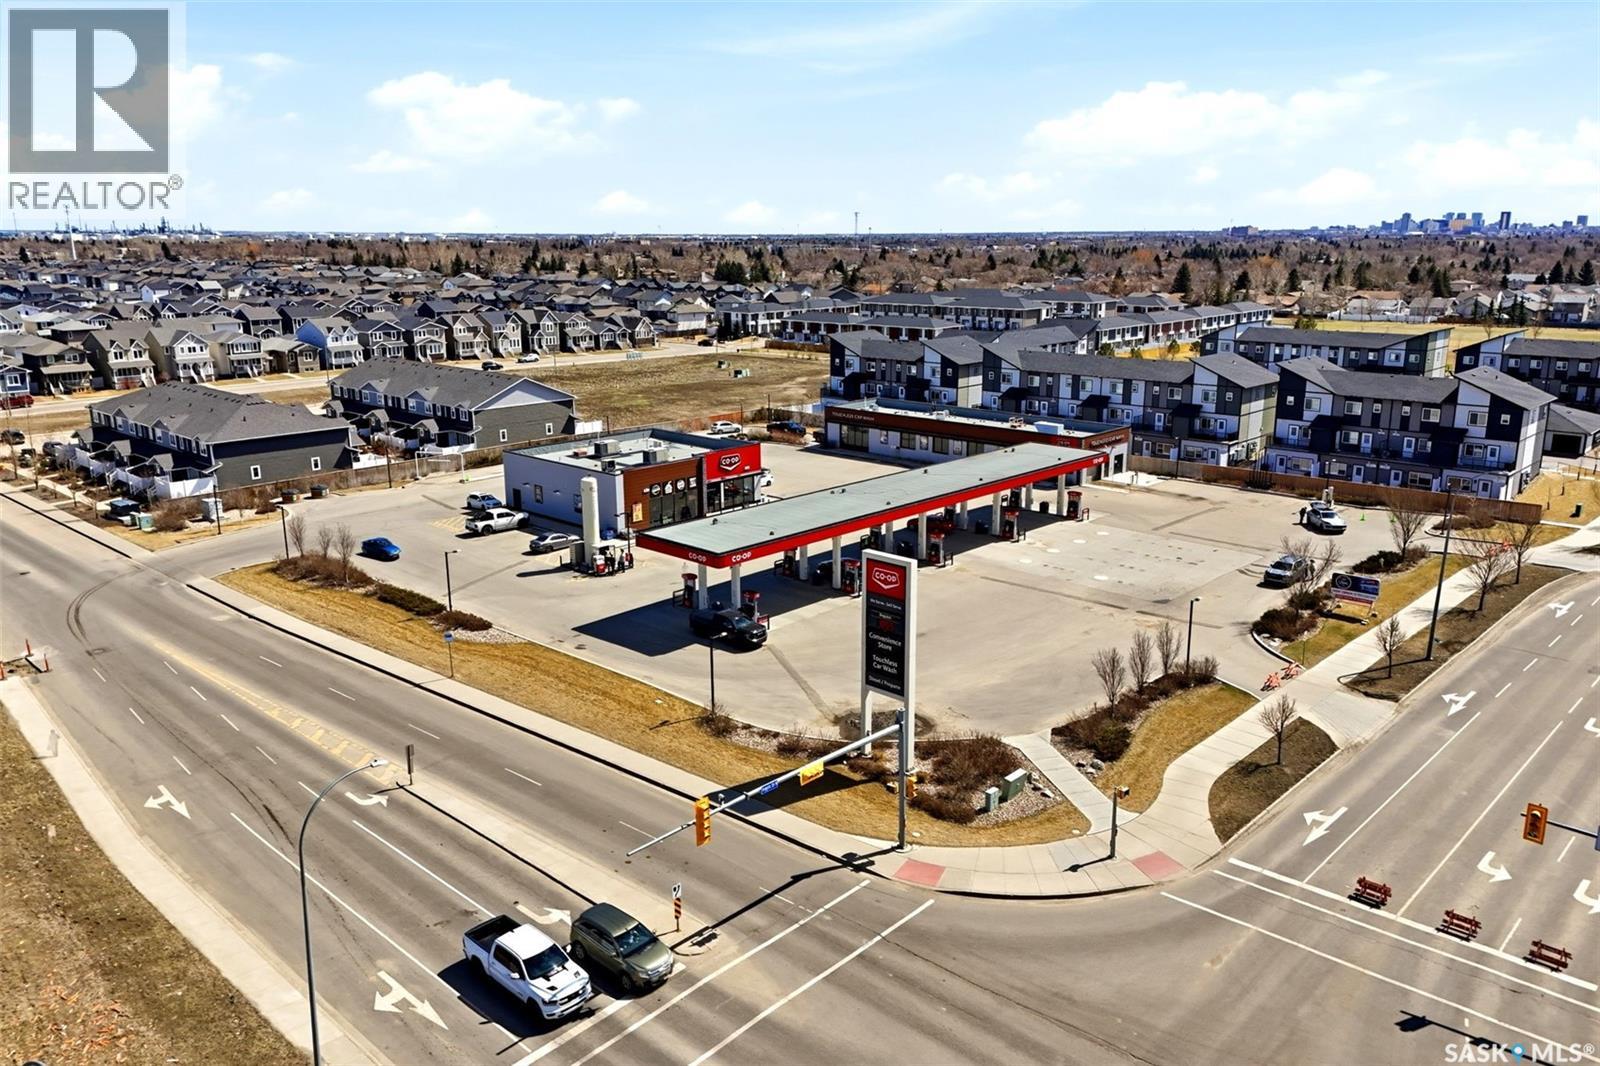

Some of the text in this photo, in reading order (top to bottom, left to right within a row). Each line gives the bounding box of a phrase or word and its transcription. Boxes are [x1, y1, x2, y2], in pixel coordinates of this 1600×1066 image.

[721, 456, 740, 465] CO-OP
[688, 552, 707, 562] CO-OP
[731, 551, 752, 562] CO-OP
[874, 571, 897, 582] CO-OP
[868, 631, 902, 647] Convenience
[877, 641, 892, 651] Store
[872, 654, 898, 667] Touchless
[873, 661, 898, 674] Car Wash
